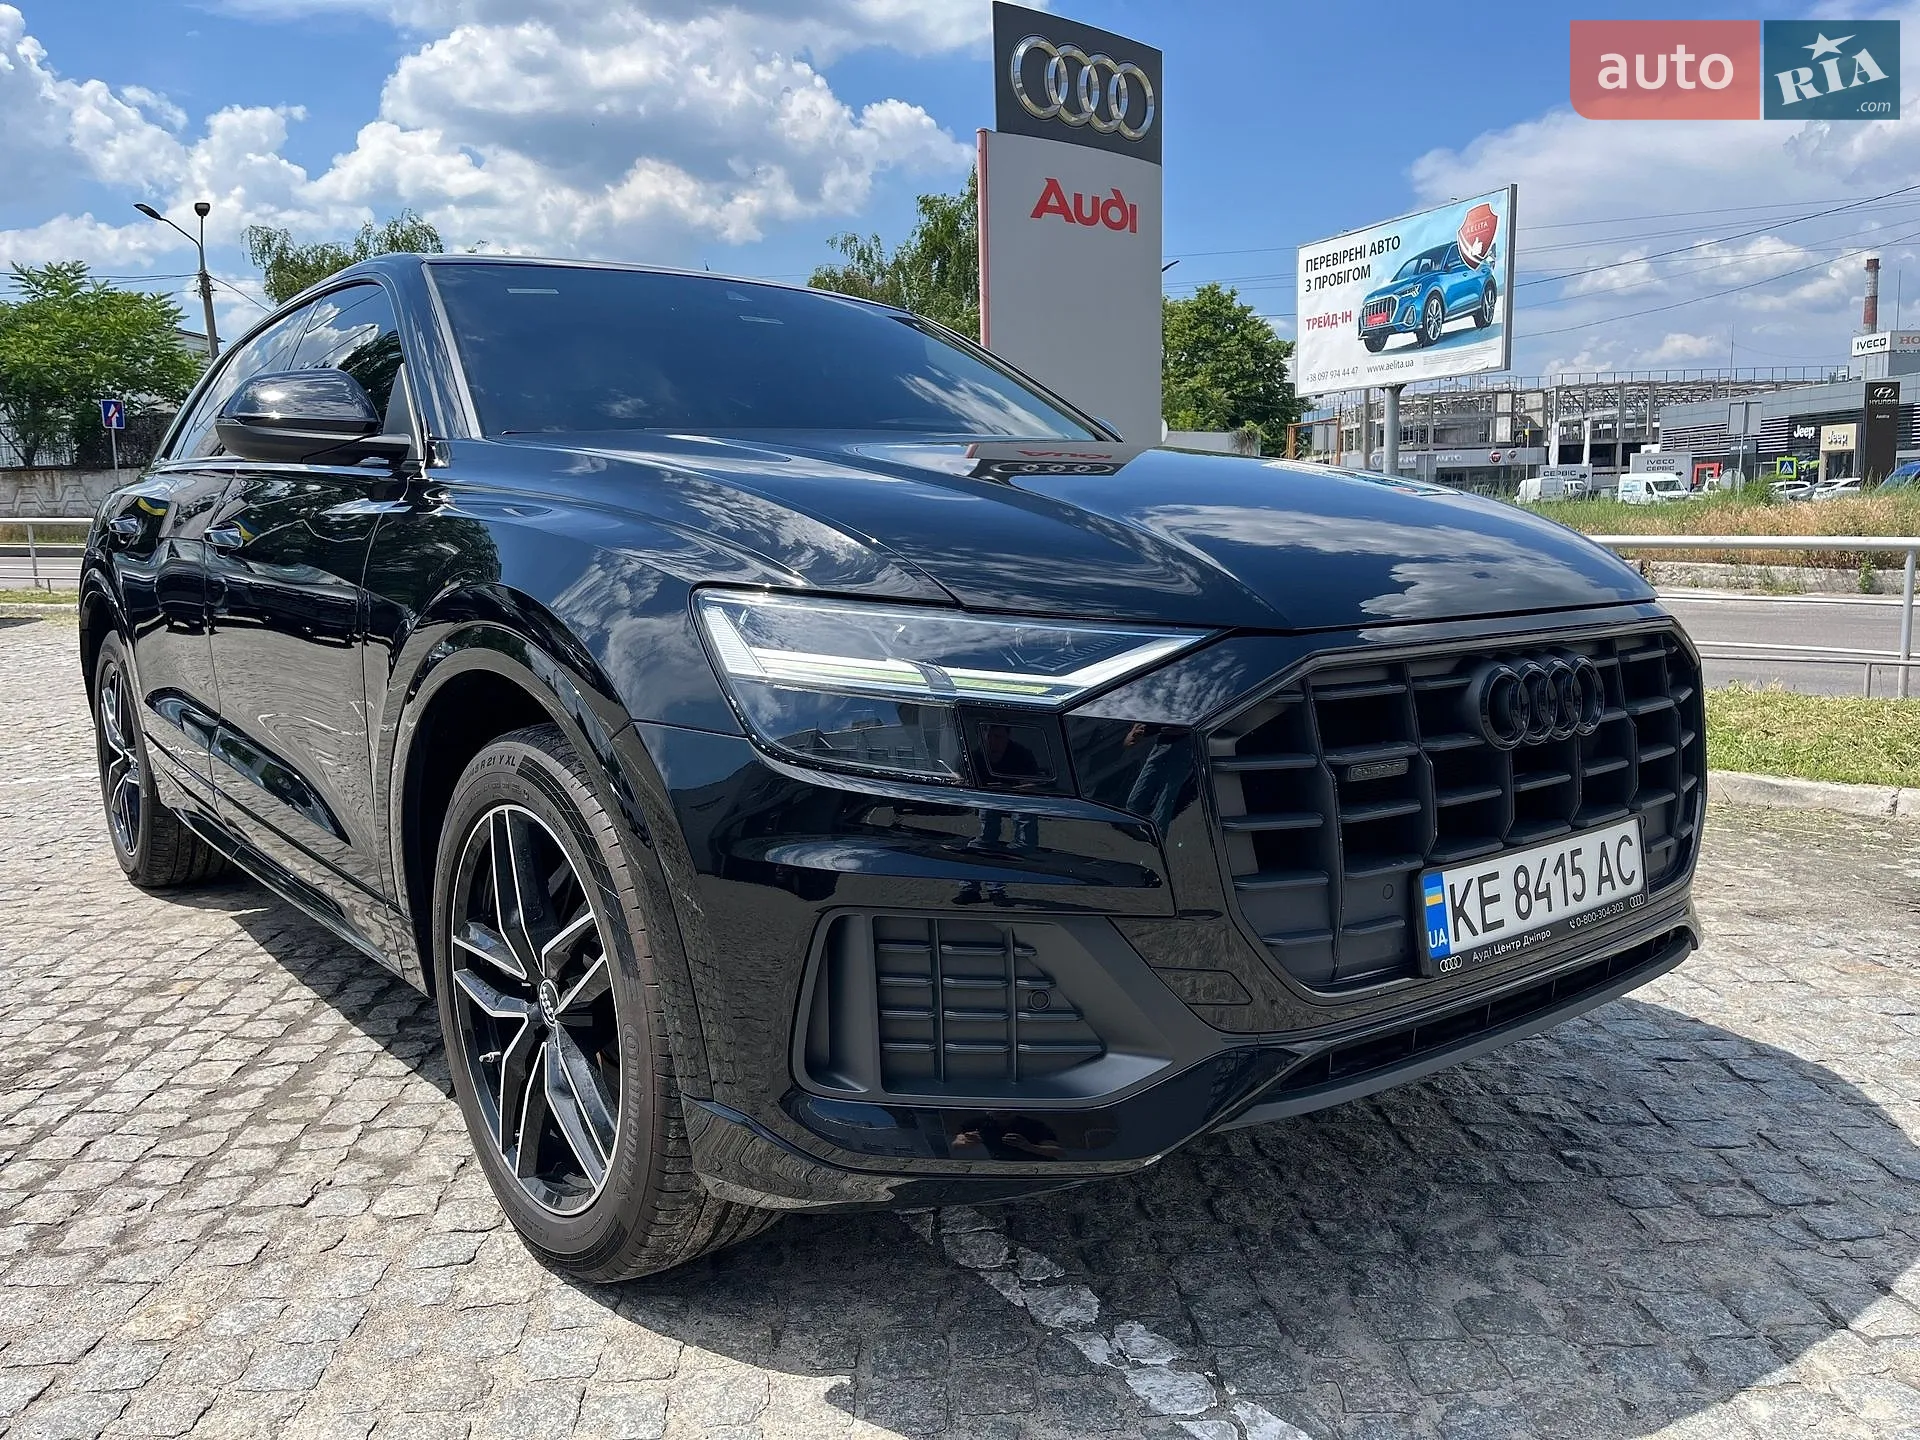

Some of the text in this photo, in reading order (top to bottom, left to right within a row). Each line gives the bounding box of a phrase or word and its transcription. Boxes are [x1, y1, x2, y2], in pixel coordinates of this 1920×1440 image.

[1030, 178, 1137, 234] Audi
[1466, 221, 1488, 233] AELITA
[1305, 235, 1401, 273] ПЕРЕВІРЕНІ АВТО
[1305, 264, 1371, 293] З ПРОБІГОМ
[1306, 310, 1352, 331] ТРЕЙД-ІН
[1856, 337, 1887, 350] IVECO
[1317, 370, 1329, 382] 097
[1341, 367, 1350, 377] 44
[1350, 366, 1359, 376] 47
[1367, 359, 1414, 374] www.aelita.ua
[1793, 424, 1815, 439] Jeep
[1828, 431, 1848, 446] Jeep
[1449, 834, 1636, 942] KE 8415 AC
[1576, 902, 1625, 927] 0-800-304-303
[1429, 928, 1448, 949] UA
[1472, 929, 1551, 963] Ауді Центр Дніпро
[620, 1023, 645, 1188] Continental
